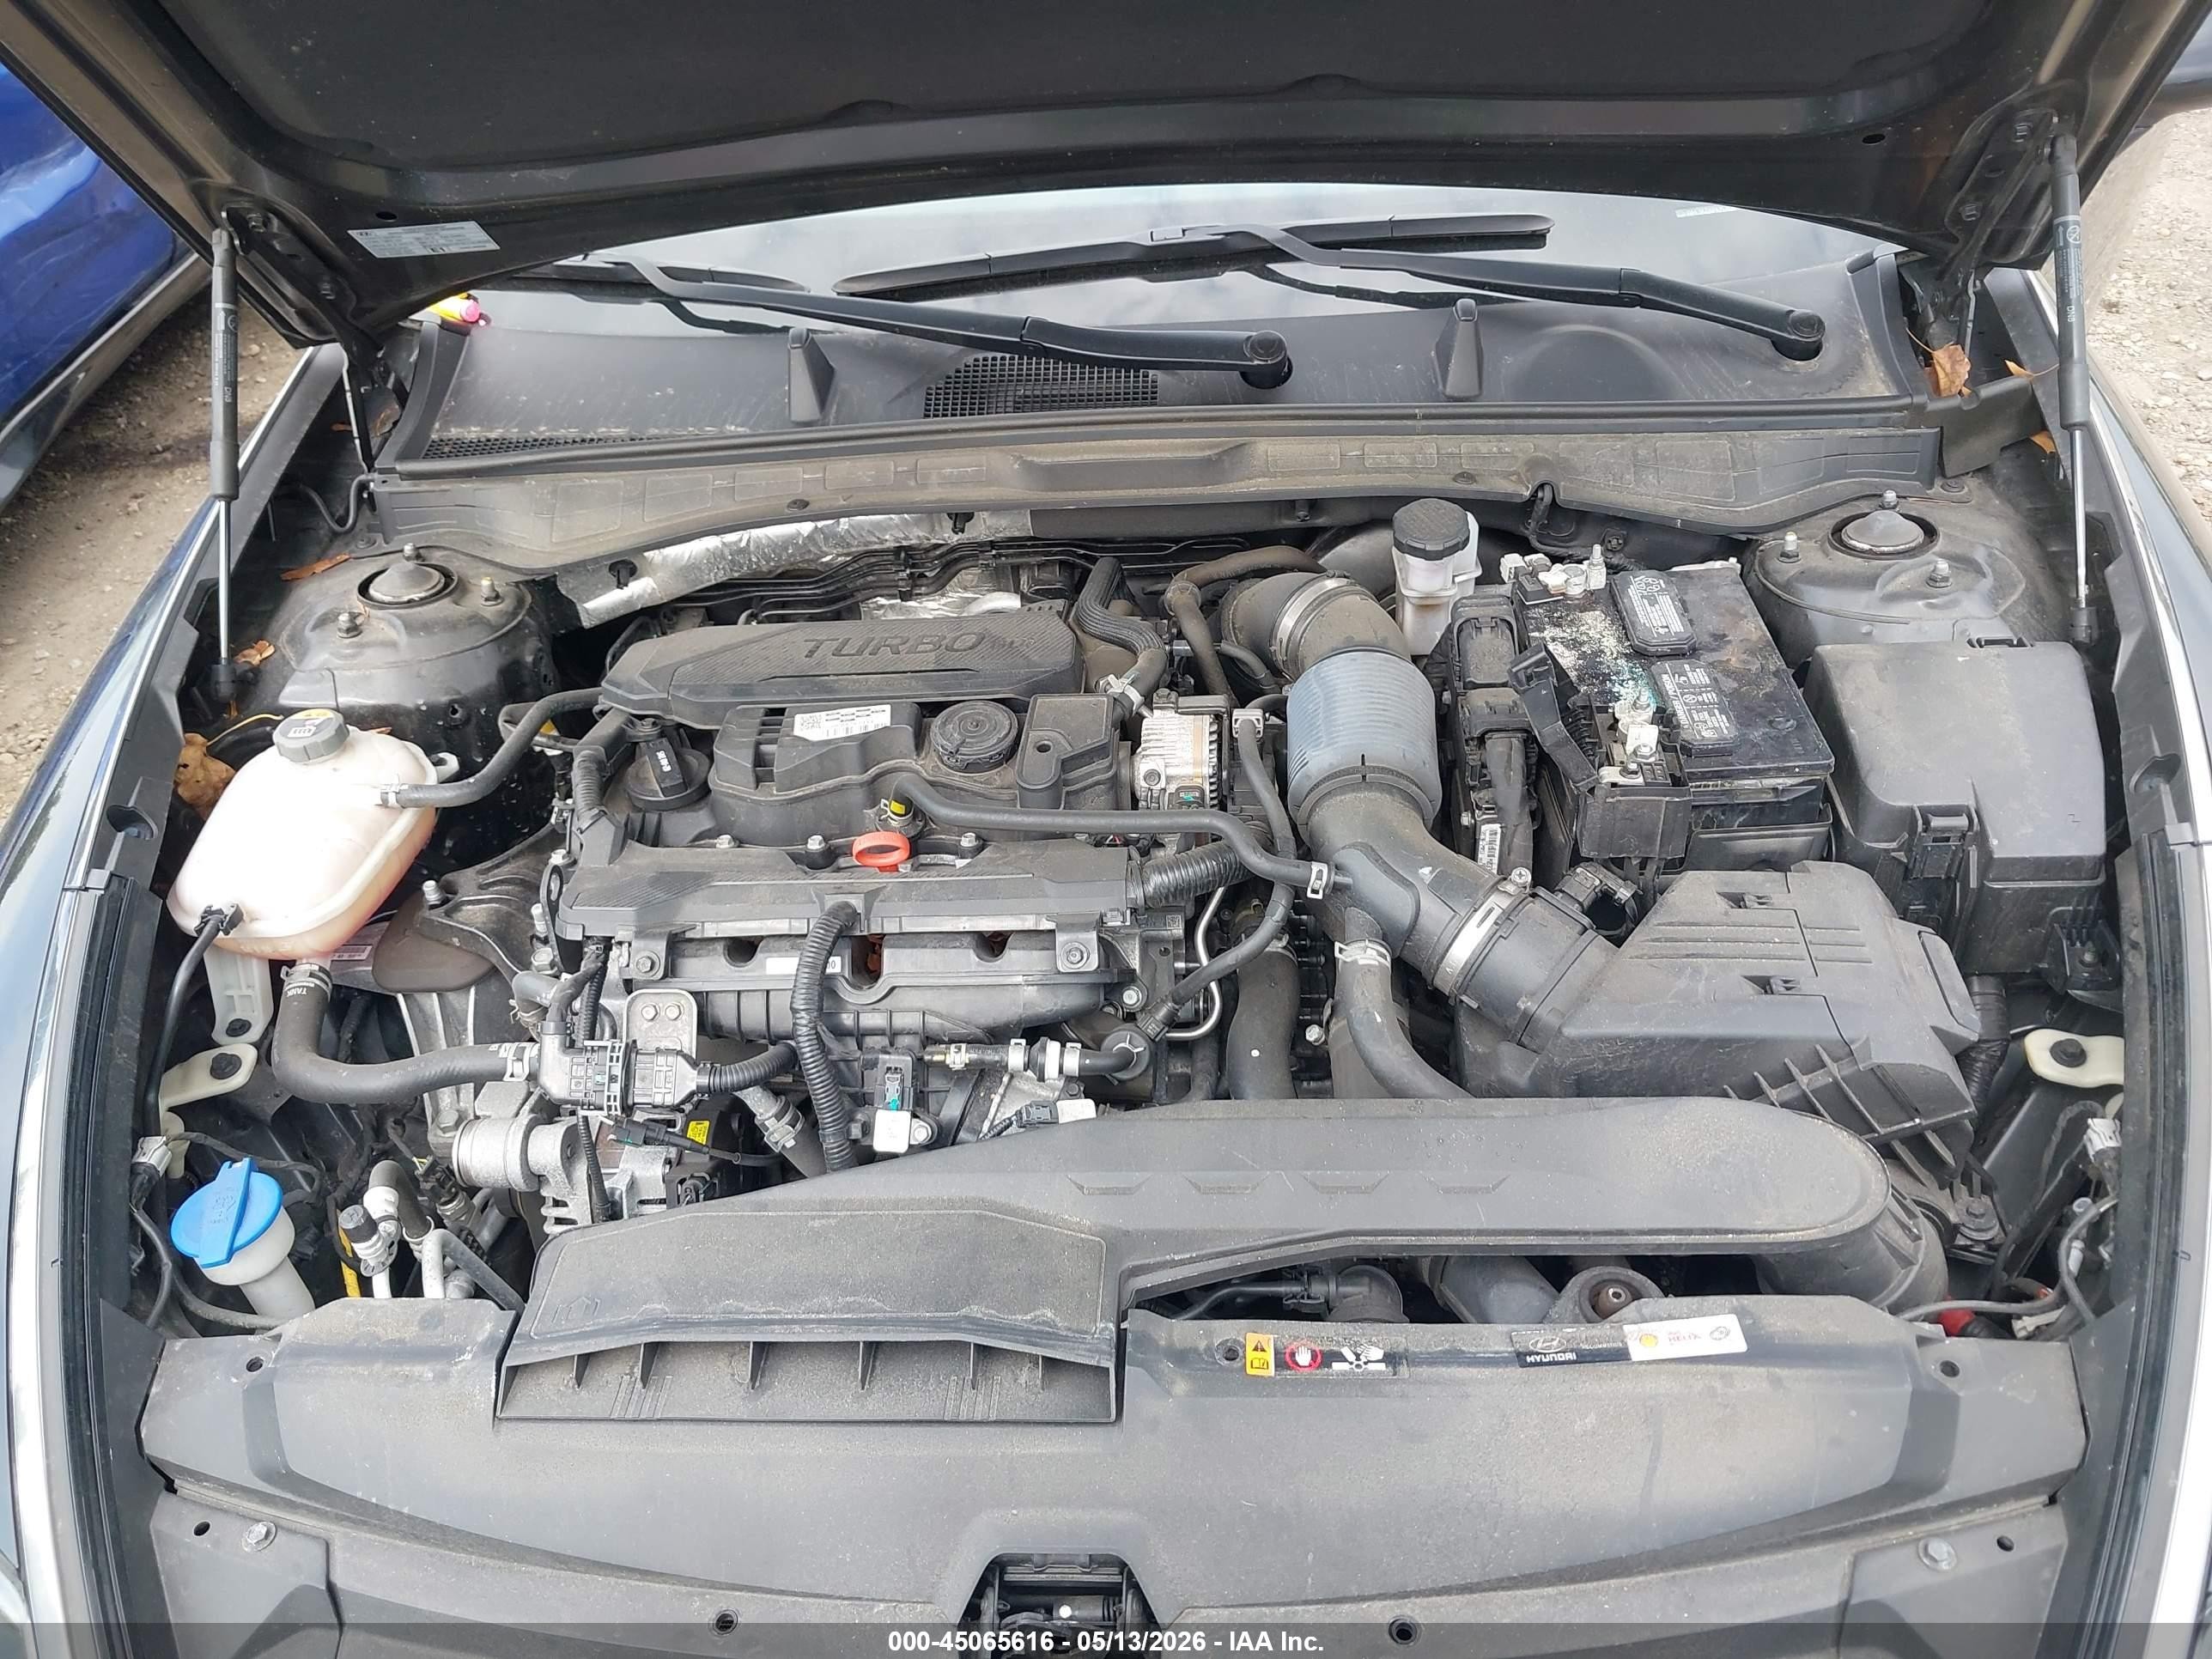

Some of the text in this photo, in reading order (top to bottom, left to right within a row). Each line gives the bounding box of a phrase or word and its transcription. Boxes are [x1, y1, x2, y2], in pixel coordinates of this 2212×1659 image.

[803, 631, 986, 658] TURBO
[1661, 673, 1677, 696] POISON
[1672, 700, 1689, 726] DANGER
[287, 987, 308, 997] TANK
[1526, 1352, 1577, 1363] HYUNDAI
